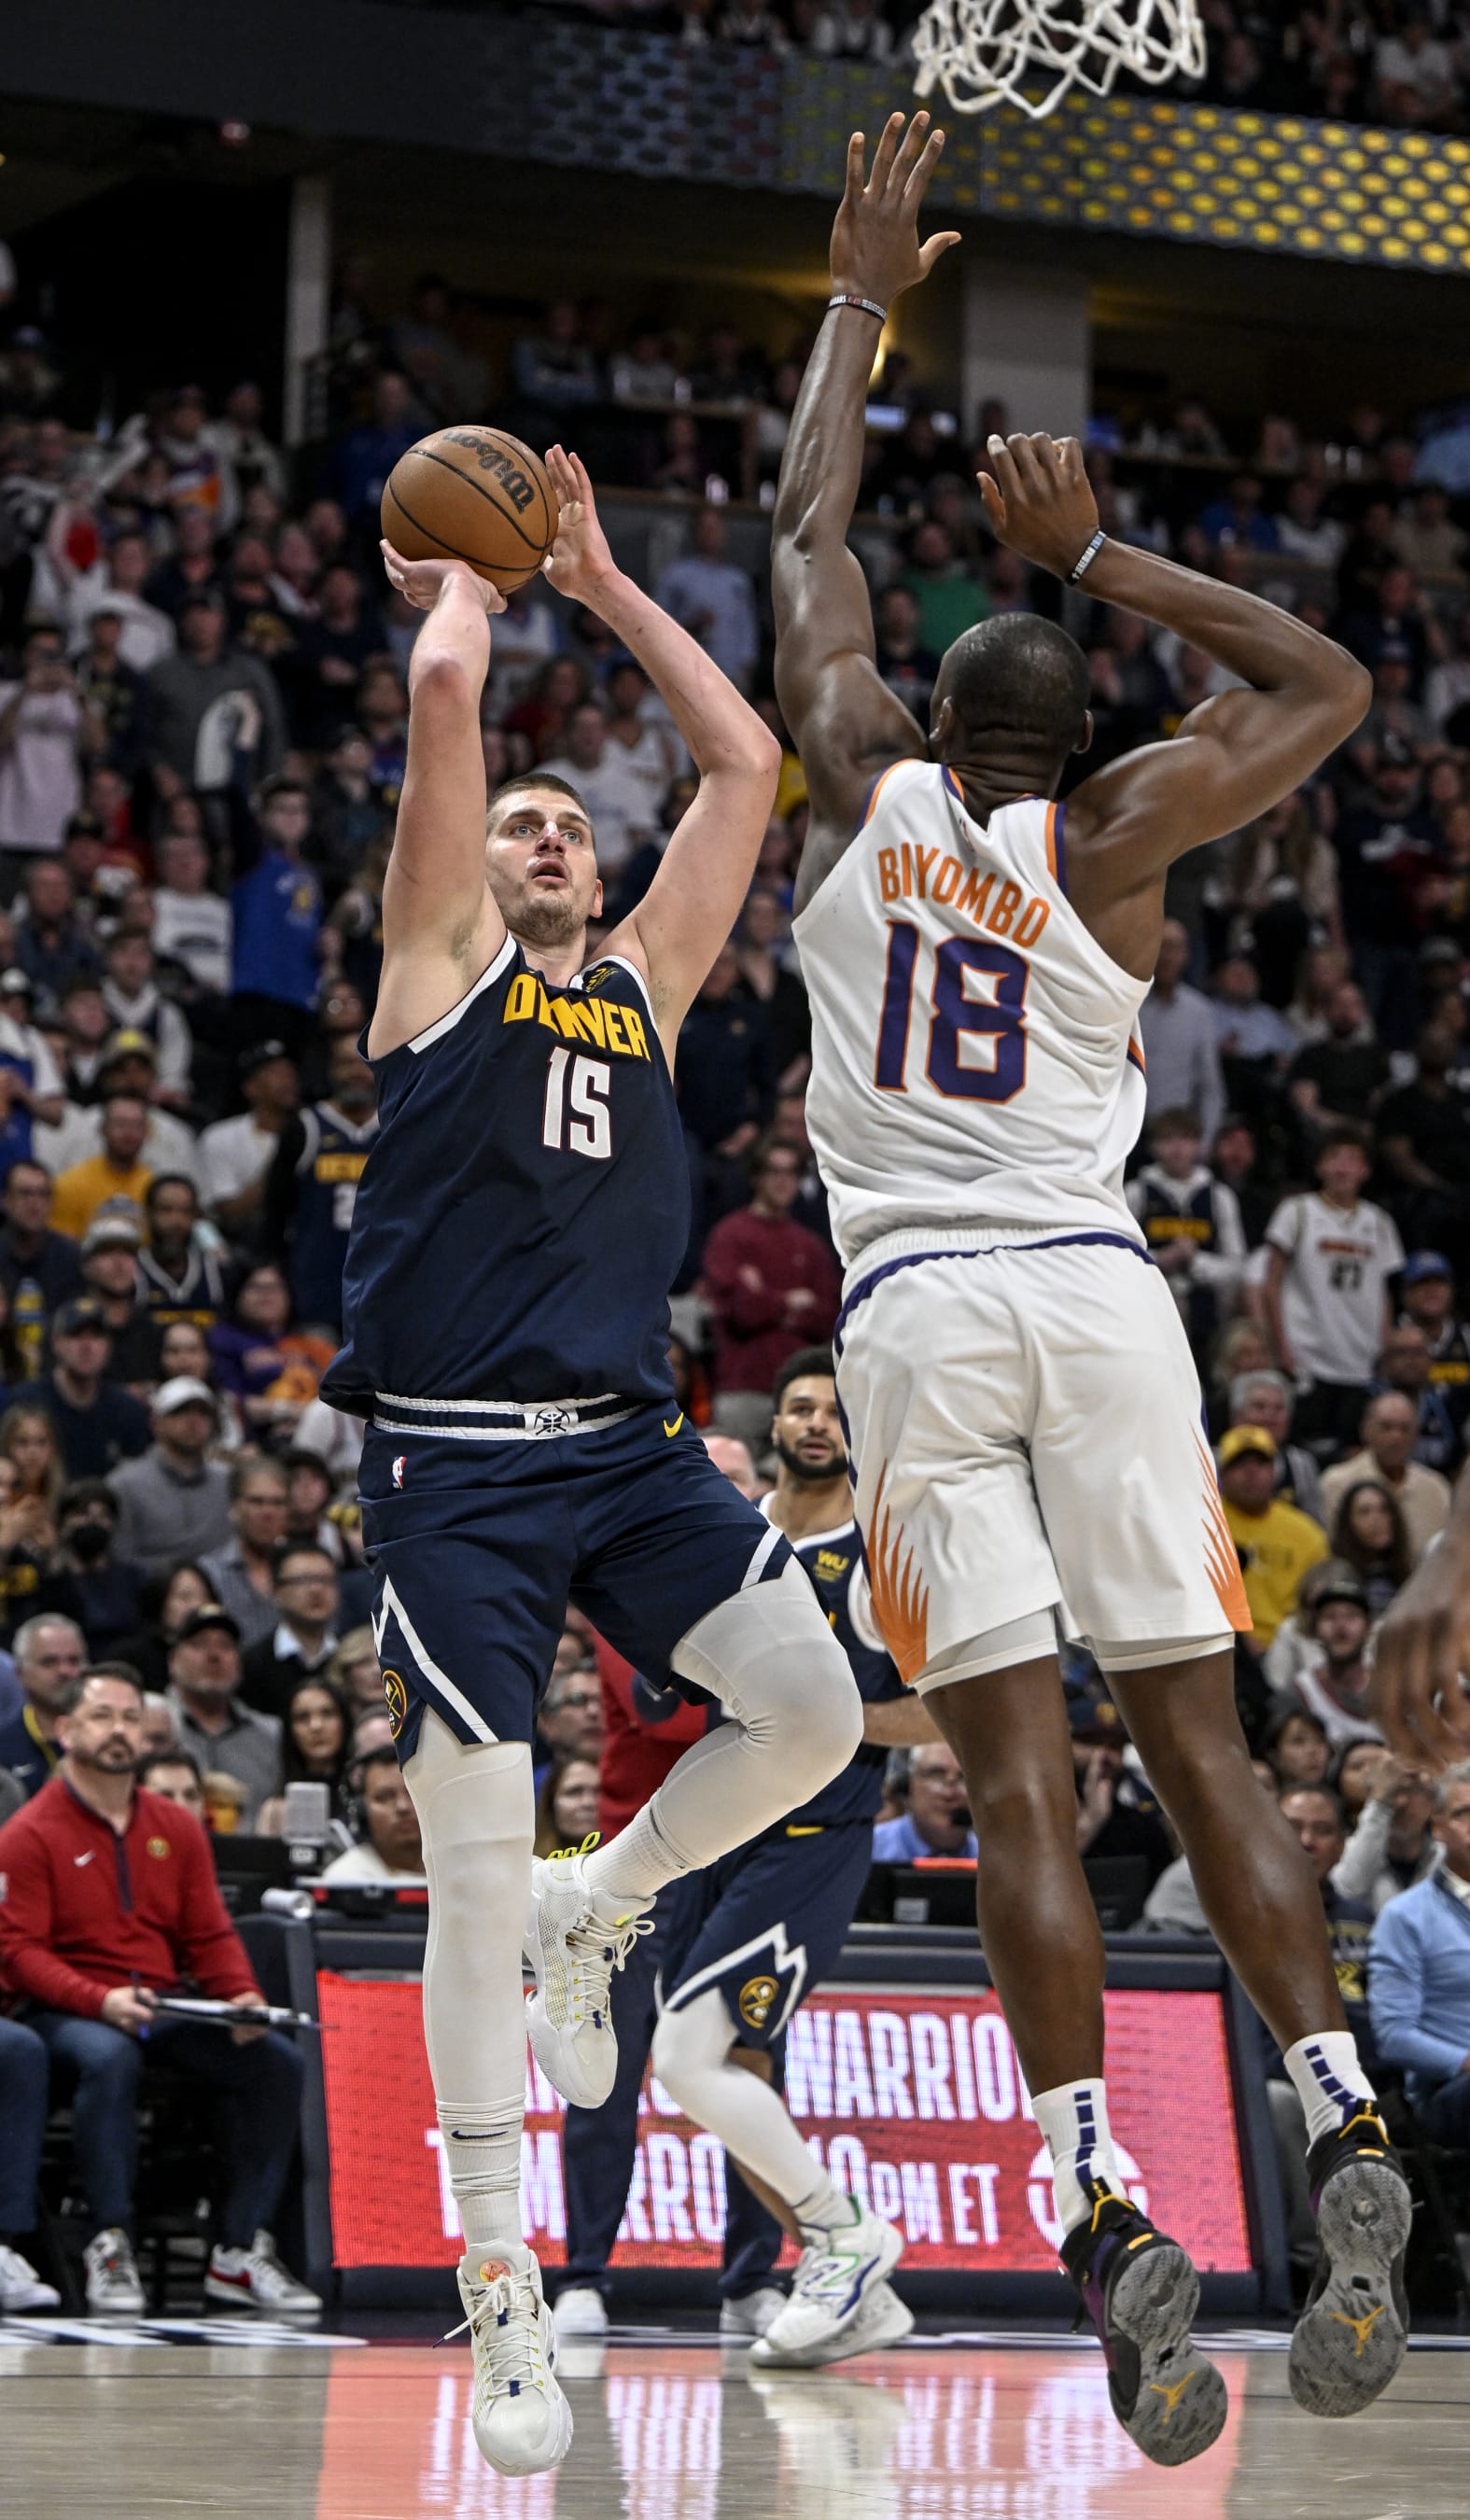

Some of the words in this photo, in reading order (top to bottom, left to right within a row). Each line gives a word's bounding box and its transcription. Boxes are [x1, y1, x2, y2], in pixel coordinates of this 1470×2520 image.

[442, 431, 535, 515] Wilson
[877, 842, 1051, 948] BIYOMBO
[875, 918, 1030, 1105] 18
[542, 1045, 612, 1159] 15
[785, 2009, 1038, 2121] WARRIO
[948, 2163, 1001, 2245] ET
